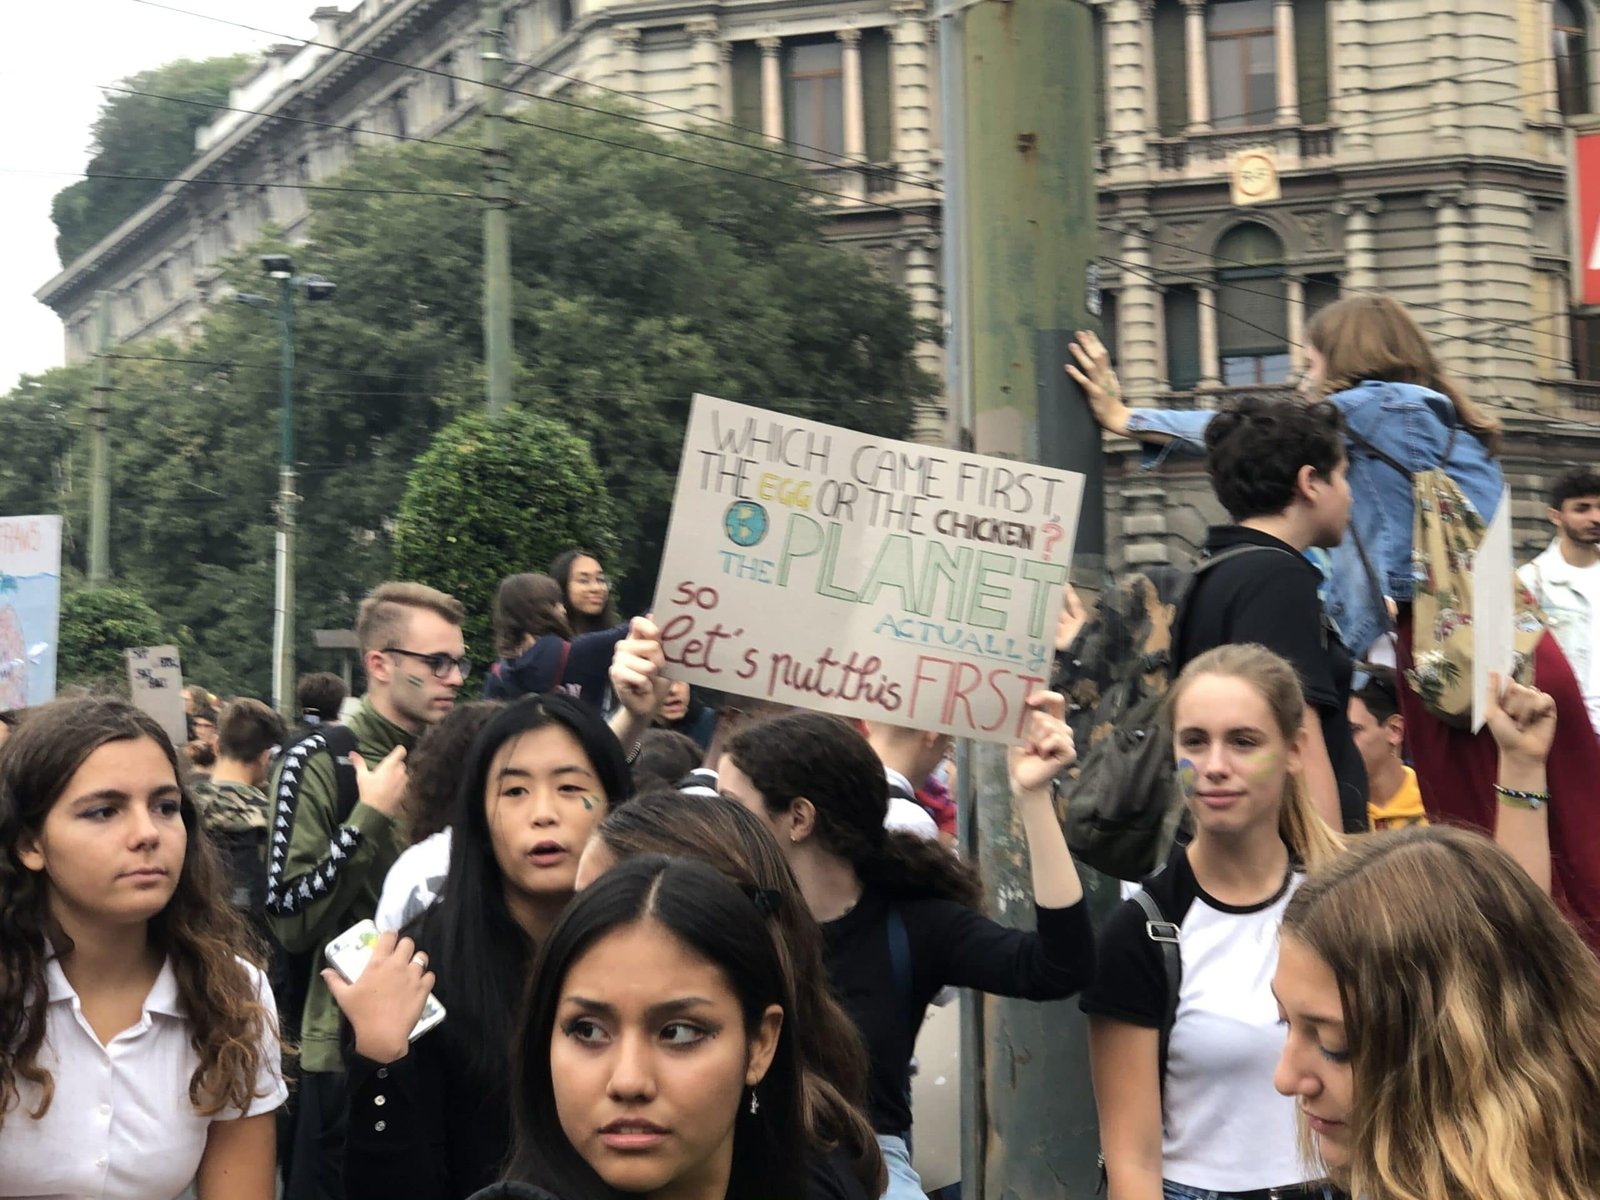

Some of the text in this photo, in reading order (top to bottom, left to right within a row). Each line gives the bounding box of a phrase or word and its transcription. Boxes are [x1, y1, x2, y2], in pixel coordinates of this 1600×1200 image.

[698, 450, 759, 500] THE
[757, 472, 812, 511] EGG
[816, 479, 859, 521] OR
[867, 487, 930, 536] THE
[712, 410, 1065, 522] WHICH CAME FIRST,
[720, 512, 1067, 639] THE PLANET
[908, 655, 1045, 739] FIRST
